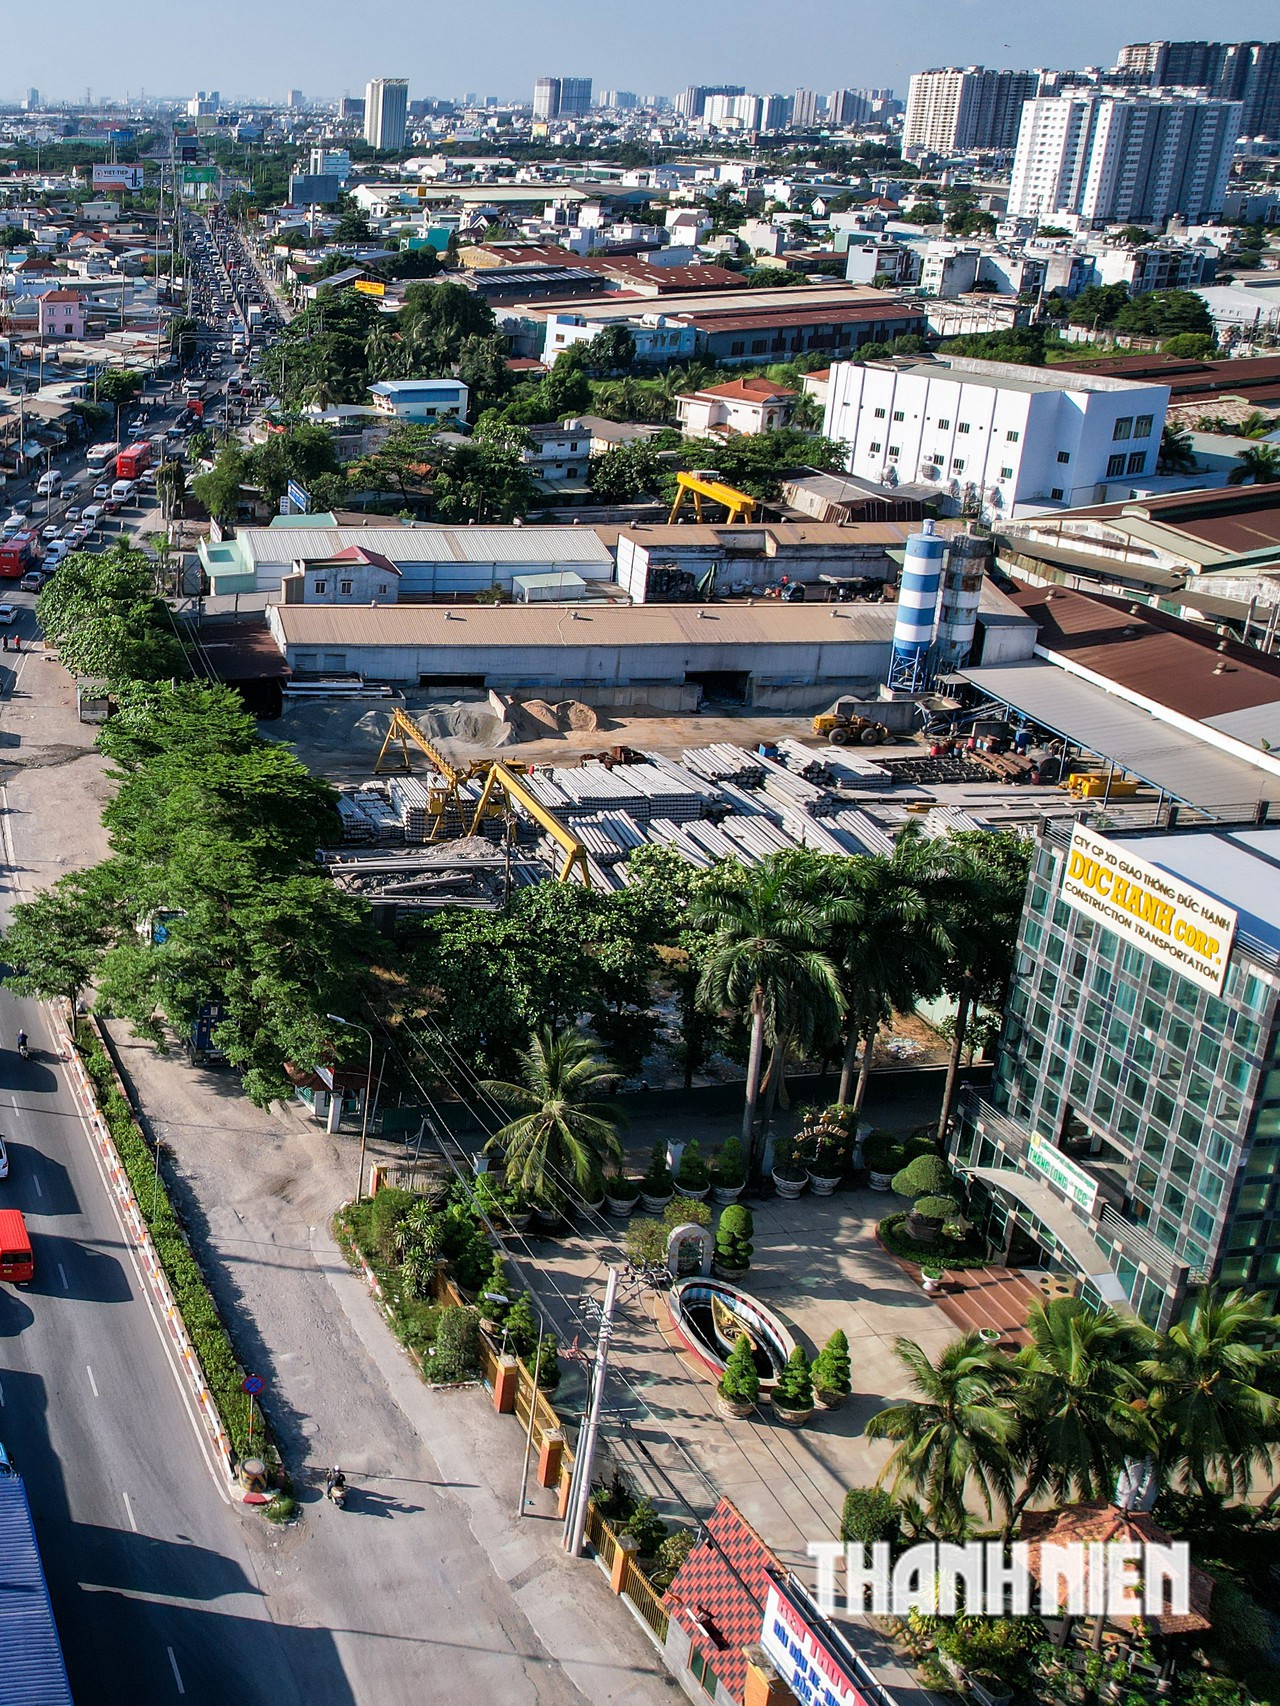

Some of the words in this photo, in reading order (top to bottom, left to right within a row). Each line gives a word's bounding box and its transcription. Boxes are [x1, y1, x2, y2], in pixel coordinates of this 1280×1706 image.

[1064, 881, 1132, 929] CONSTRUCTION
[1133, 923, 1219, 982] TRANSPORTATION
[1068, 849, 1114, 896] DUC
[1110, 874, 1176, 936] HANH
[1173, 918, 1221, 965] CORP.
[1073, 835, 1090, 850] CTY
[1091, 845, 1104, 857] CP
[1105, 851, 1117, 866] XD
[1118, 861, 1142, 880] GIAO
[1143, 873, 1175, 899] THÔNG
[1176, 893, 1199, 913] ĐỨC
[1200, 906, 1230, 932] HẠNH
